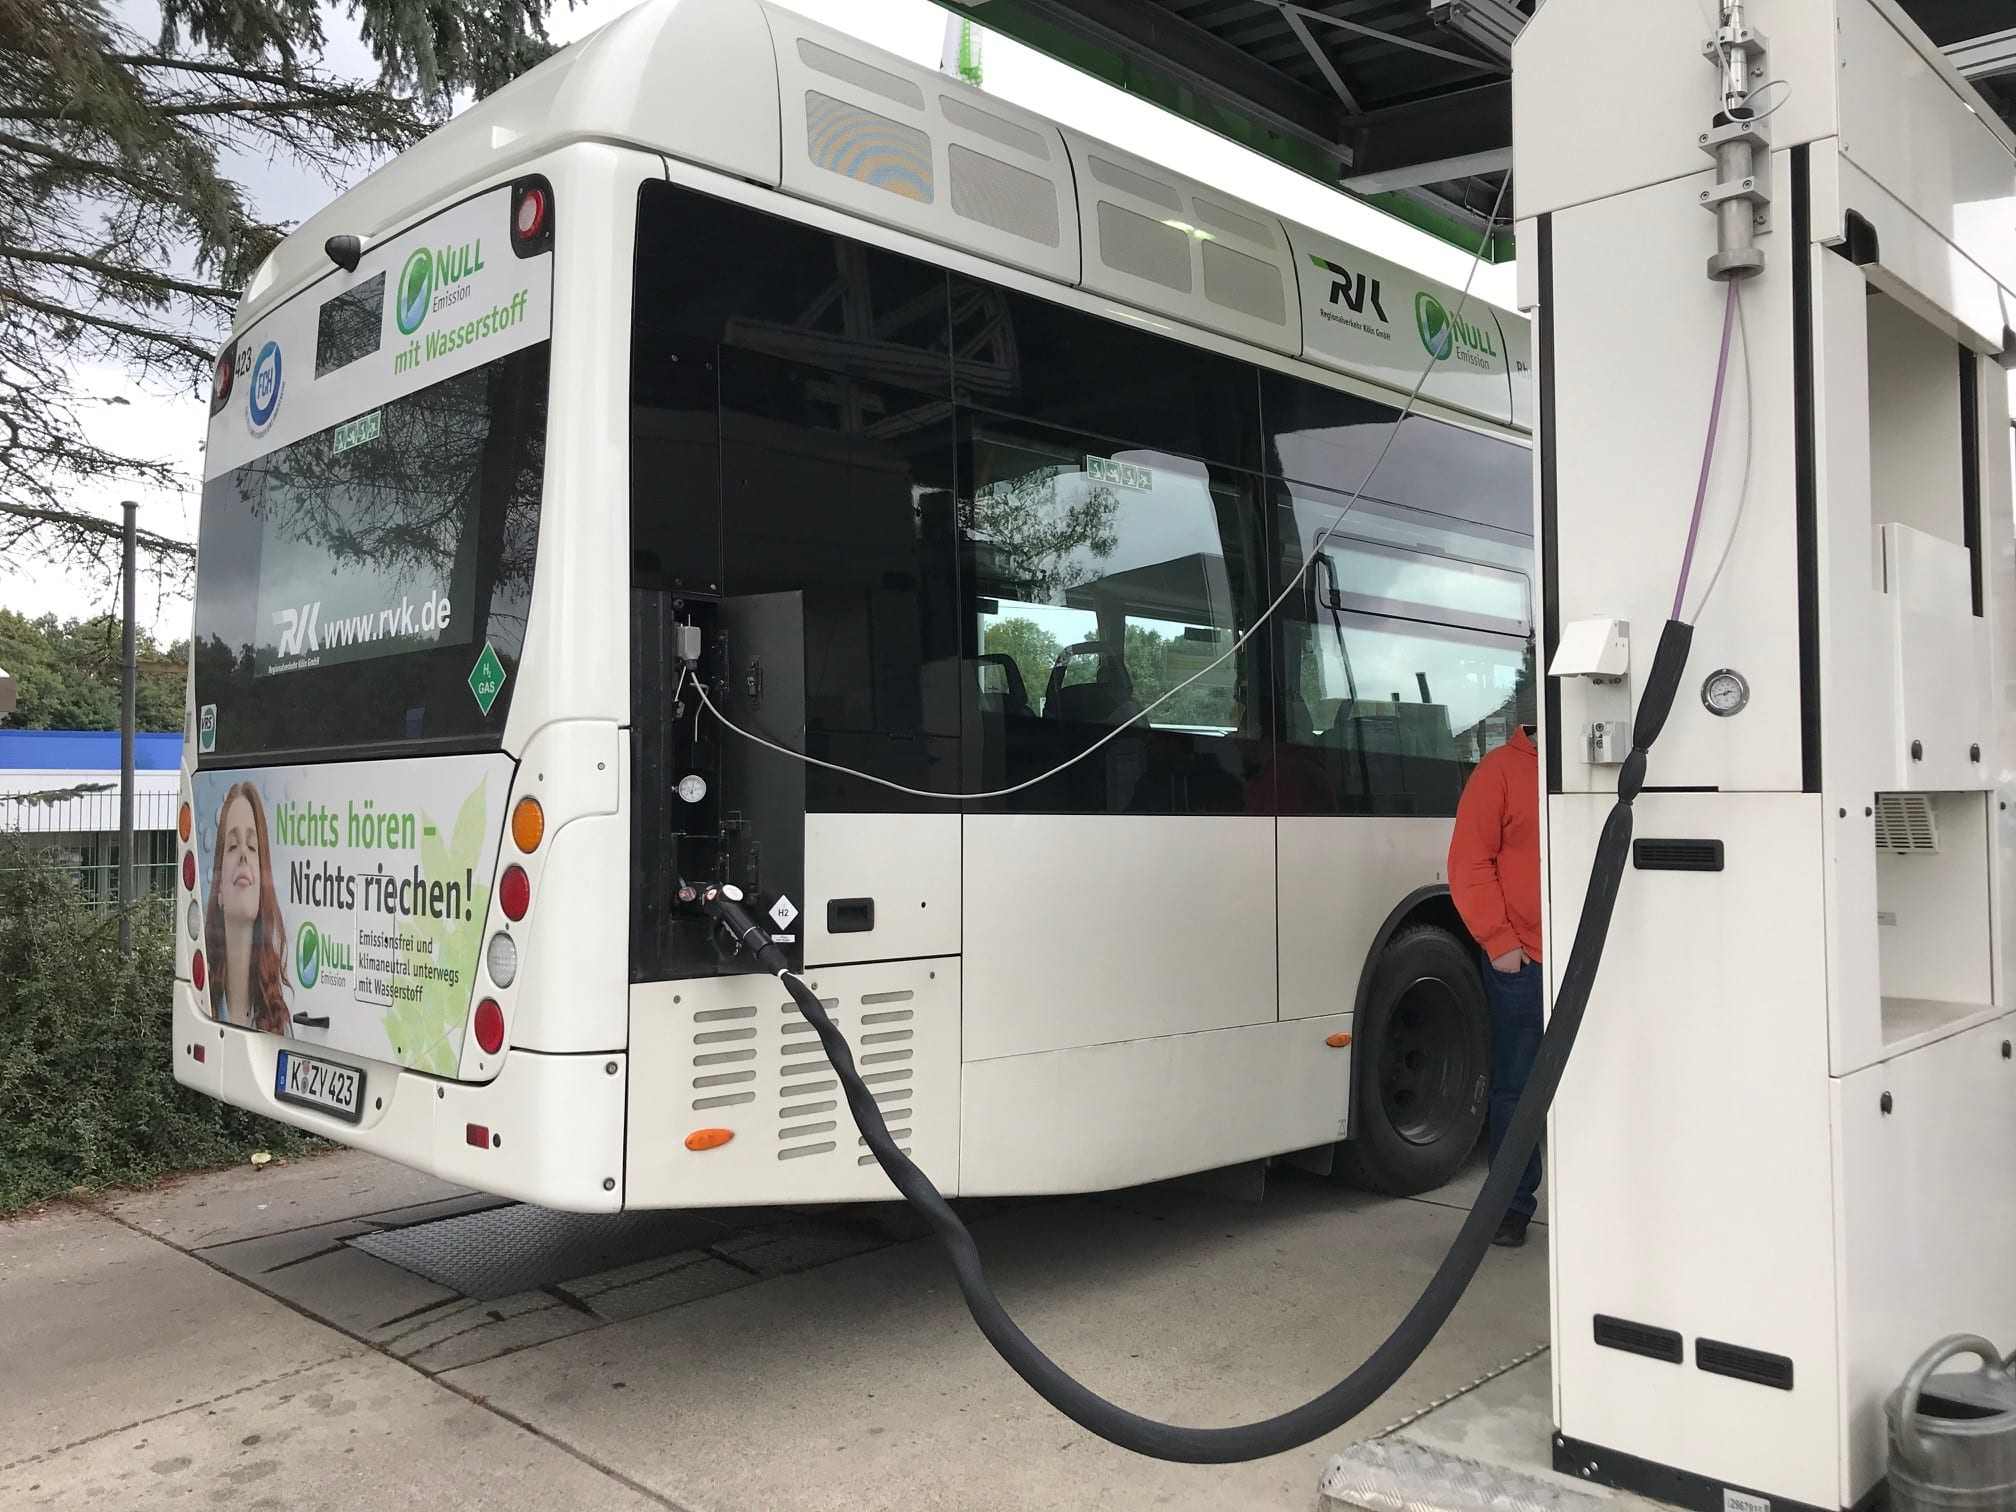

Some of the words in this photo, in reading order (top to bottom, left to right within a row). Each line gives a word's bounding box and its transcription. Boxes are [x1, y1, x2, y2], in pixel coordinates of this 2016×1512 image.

[434, 238, 485, 291] NULL
[432, 283, 471, 313] Emission
[394, 338, 421, 375] mit
[426, 288, 528, 362] Wasserstoff
[234, 345, 252, 379] 423
[1456, 346, 1491, 369] Emission
[257, 367, 274, 400] FCH
[324, 589, 451, 650] www.rvk.de
[478, 681, 496, 695] GAS
[275, 800, 339, 849] Nichts
[348, 800, 416, 849] hören
[290, 859, 355, 910] Nichts
[363, 862, 473, 922] riechen!
[778, 909, 789, 917] H2
[321, 934, 354, 971] NULL
[359, 929, 414, 952] Emissionsfrei
[416, 937, 433, 954] und
[320, 970, 346, 988] Emission
[359, 952, 411, 976] klimaneutral
[413, 963, 460, 987] unterwegs
[358, 976, 373, 994] mit
[374, 978, 424, 1003] Wasserstoff
[290, 1060, 301, 1092] K
[309, 1064, 328, 1097] ZY
[328, 1071, 354, 1106] 423
